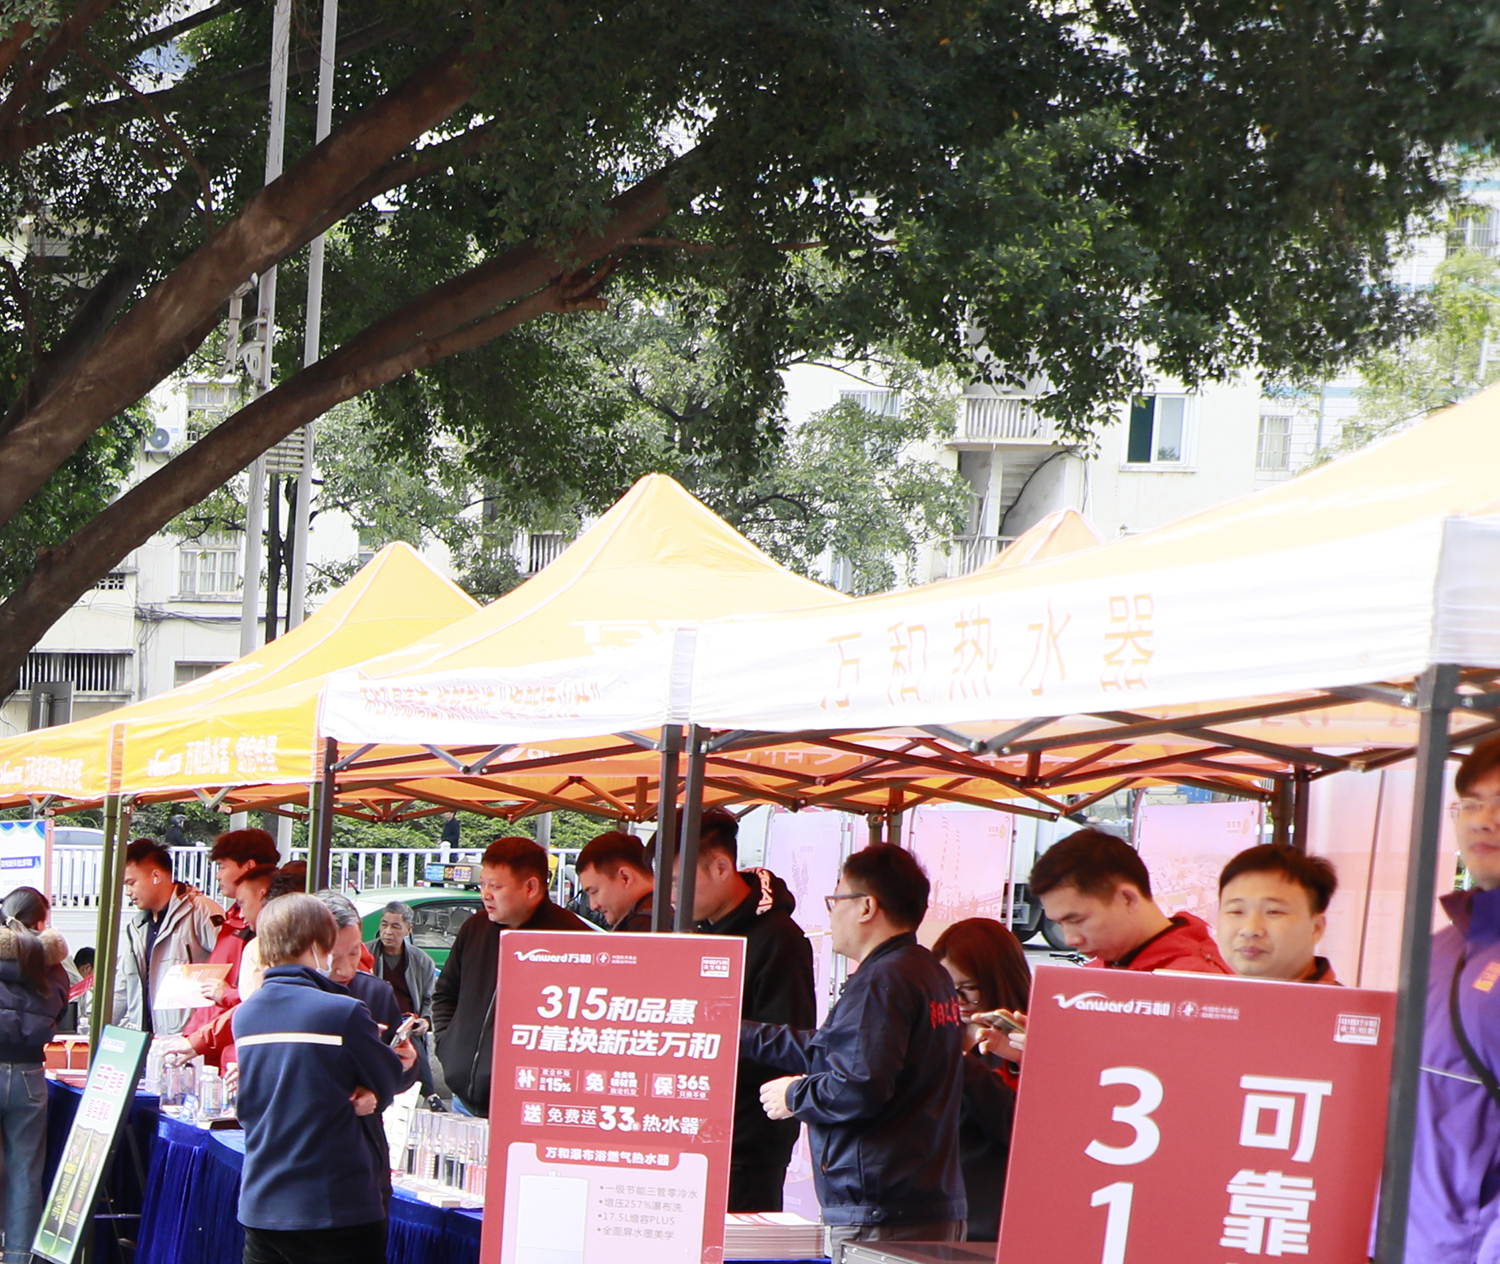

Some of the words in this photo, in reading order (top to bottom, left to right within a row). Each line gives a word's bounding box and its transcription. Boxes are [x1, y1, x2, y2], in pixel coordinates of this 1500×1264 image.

[818, 592, 1157, 712] 万和热水器
[536, 985, 699, 1025] 315和品惠
[510, 1024, 722, 1061] 可靠换新选万和
[547, 1108, 598, 1127] 免费送
[642, 1115, 700, 1136] 热水器
